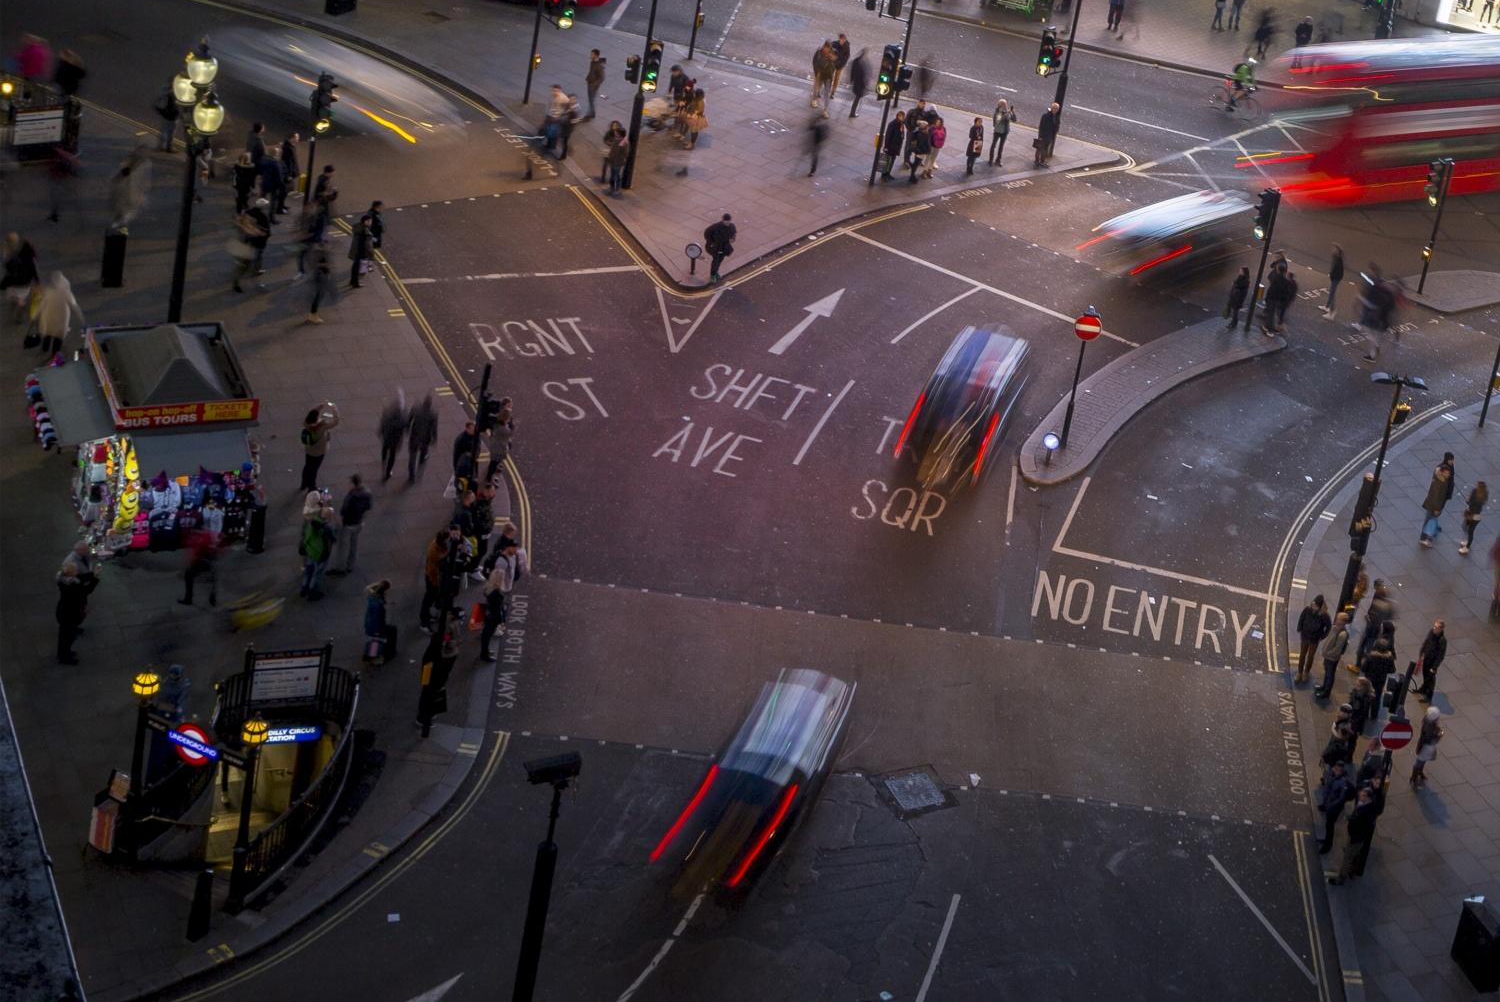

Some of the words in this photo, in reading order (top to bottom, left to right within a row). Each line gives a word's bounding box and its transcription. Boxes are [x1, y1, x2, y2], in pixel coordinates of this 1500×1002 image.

[731, 56, 779, 72] LOOK
[469, 316, 595, 361] RGNT
[542, 377, 609, 422] ST
[689, 363, 816, 421] SHFT
[124, 416, 150, 428] BUS
[154, 413, 198, 426] TOURS
[651, 422, 763, 478] AVE
[851, 478, 947, 536] SQR
[508, 593, 529, 624] LOOK
[1031, 570, 1095, 625] NO
[1102, 585, 1257, 658] ENTRY
[503, 629, 526, 663] BOTH
[495, 671, 519, 709] WAYS
[1277, 691, 1299, 731] WAYS
[168, 731, 217, 758] UNDERGROUND
[267, 728, 288, 736] DILLY
[289, 726, 316, 735] CIRCUS
[1282, 731, 1304, 768] BOTH
[1286, 769, 1308, 806] LOOK
